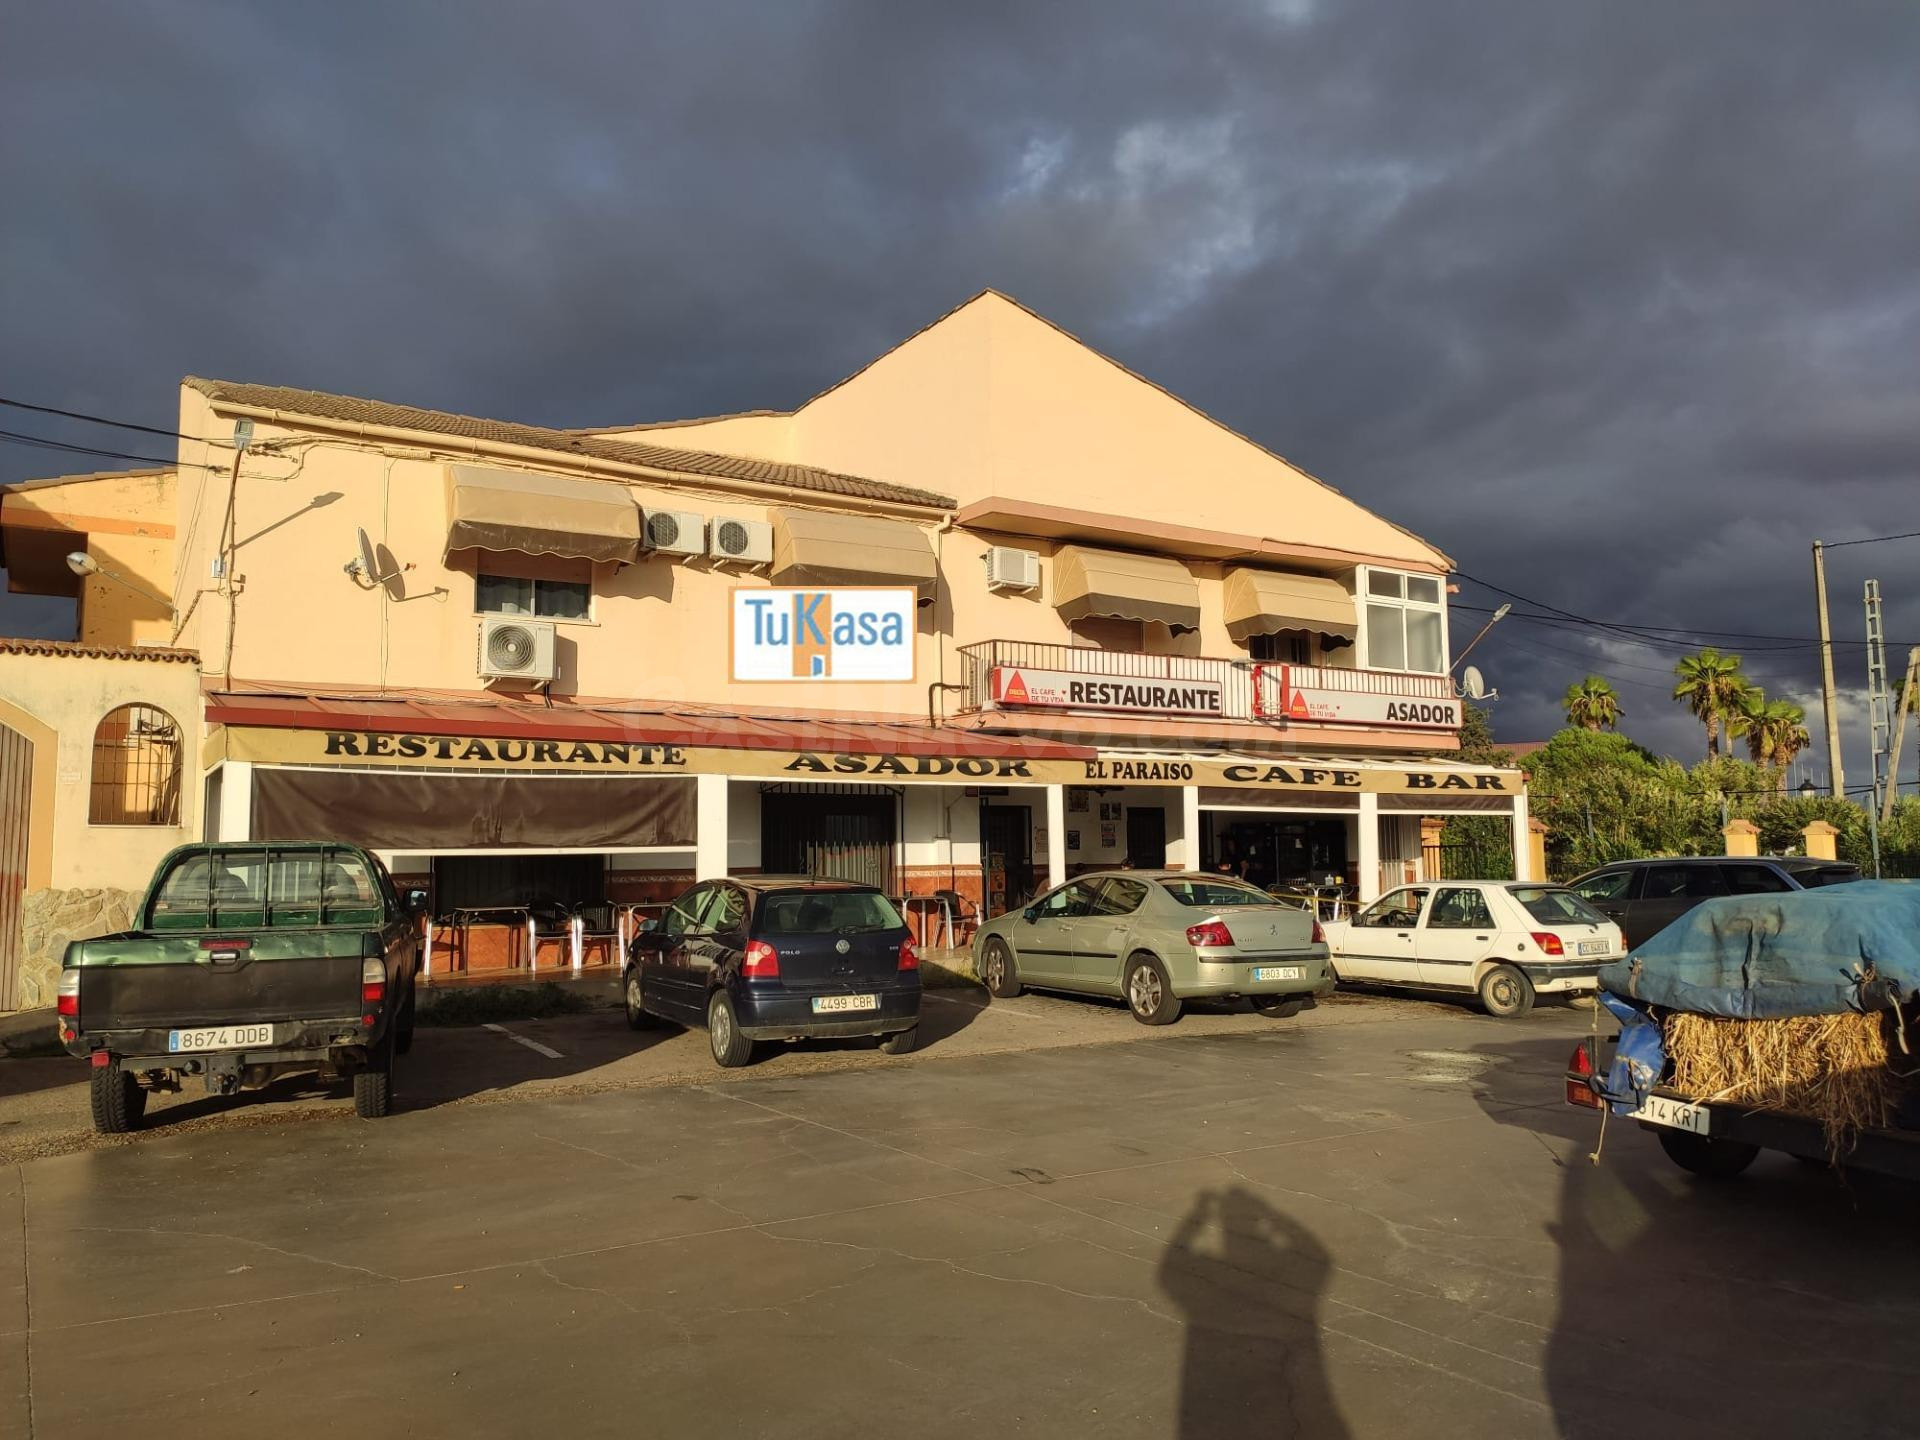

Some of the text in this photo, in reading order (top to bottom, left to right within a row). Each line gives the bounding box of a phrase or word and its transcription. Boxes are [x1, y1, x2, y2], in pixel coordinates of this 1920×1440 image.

[1069, 681, 1220, 711] RESTAURANTE
[1386, 702, 1455, 724] ASADOR
[324, 731, 687, 766] RESTAURANTE
[783, 752, 1032, 778] ASADOR
[1085, 760, 1193, 781] EL PARAISO
[1223, 765, 1507, 790] CAFE BAR
[1261, 969, 1280, 979] 6803
[820, 996, 874, 1010] 4499 CBR
[182, 1027, 269, 1048] 8674 DDB
[1672, 1105, 1702, 1131] KRT
